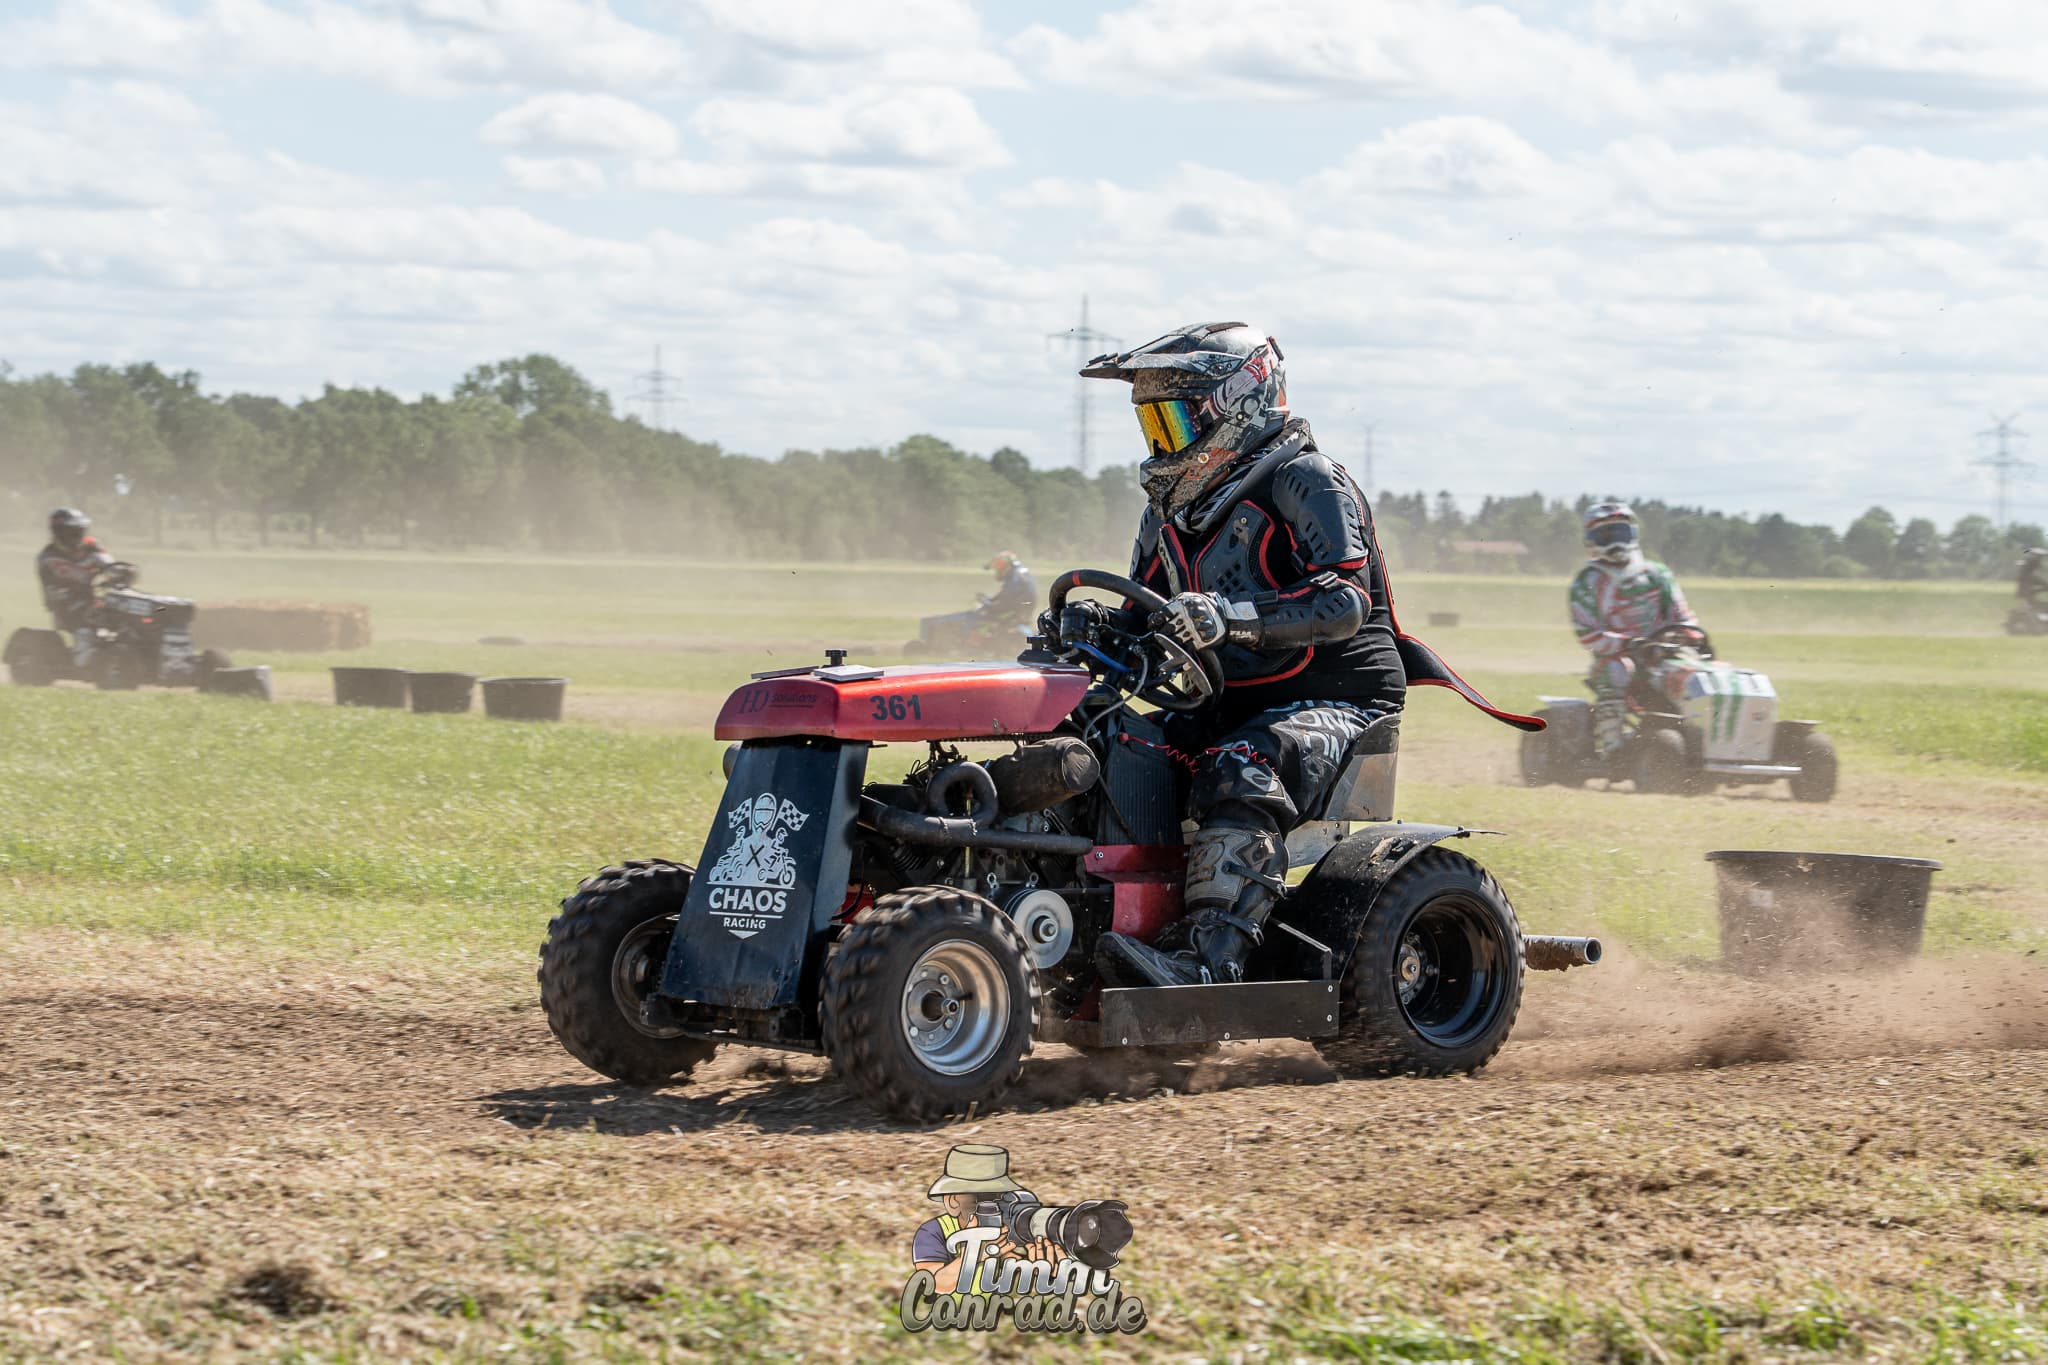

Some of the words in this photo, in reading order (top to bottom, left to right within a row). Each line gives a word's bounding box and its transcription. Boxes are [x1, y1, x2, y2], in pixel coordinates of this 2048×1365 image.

[870, 694, 921, 720] 361
[709, 887, 787, 913] CHAOS
[723, 917, 767, 929] RACING
